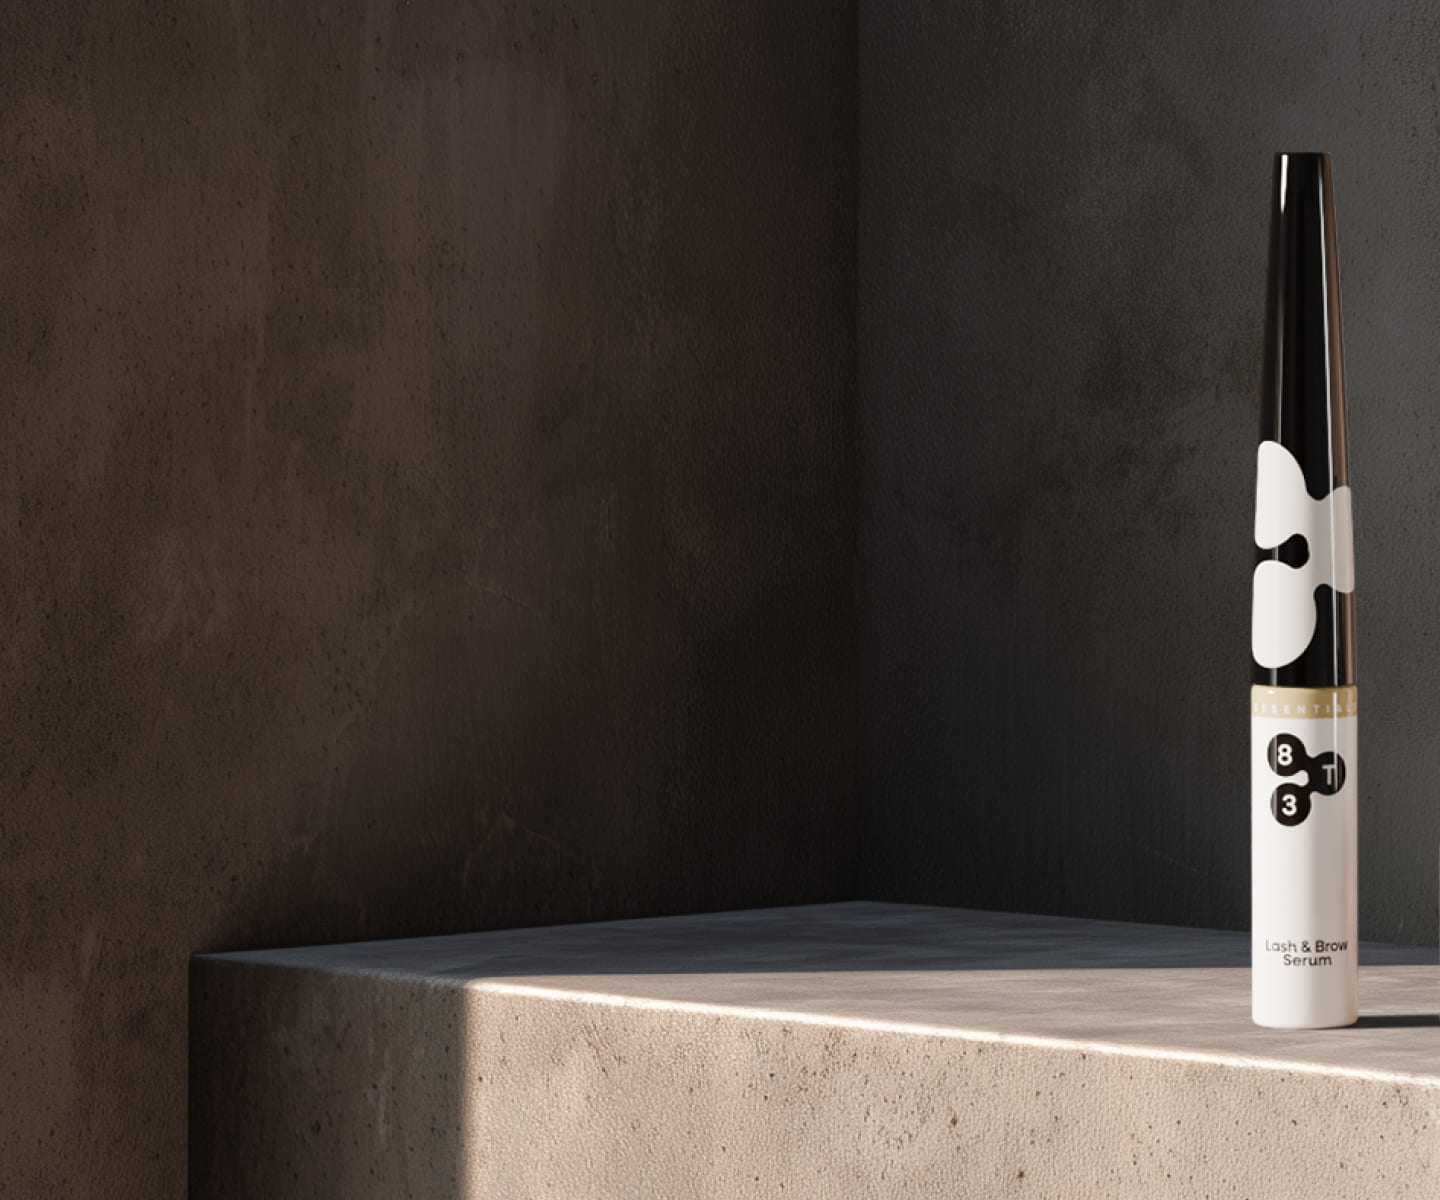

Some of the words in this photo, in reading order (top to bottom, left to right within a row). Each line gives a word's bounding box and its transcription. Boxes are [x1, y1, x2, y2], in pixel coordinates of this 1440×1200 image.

[1277, 743, 1293, 766] 8
[1322, 764, 1336, 785] T
[1281, 794, 1297, 816] 3
[1265, 939, 1297, 952] Lash
[1301, 940, 1311, 953] &
[1315, 940, 1348, 953] Brow
[1283, 954, 1332, 966] Serum
